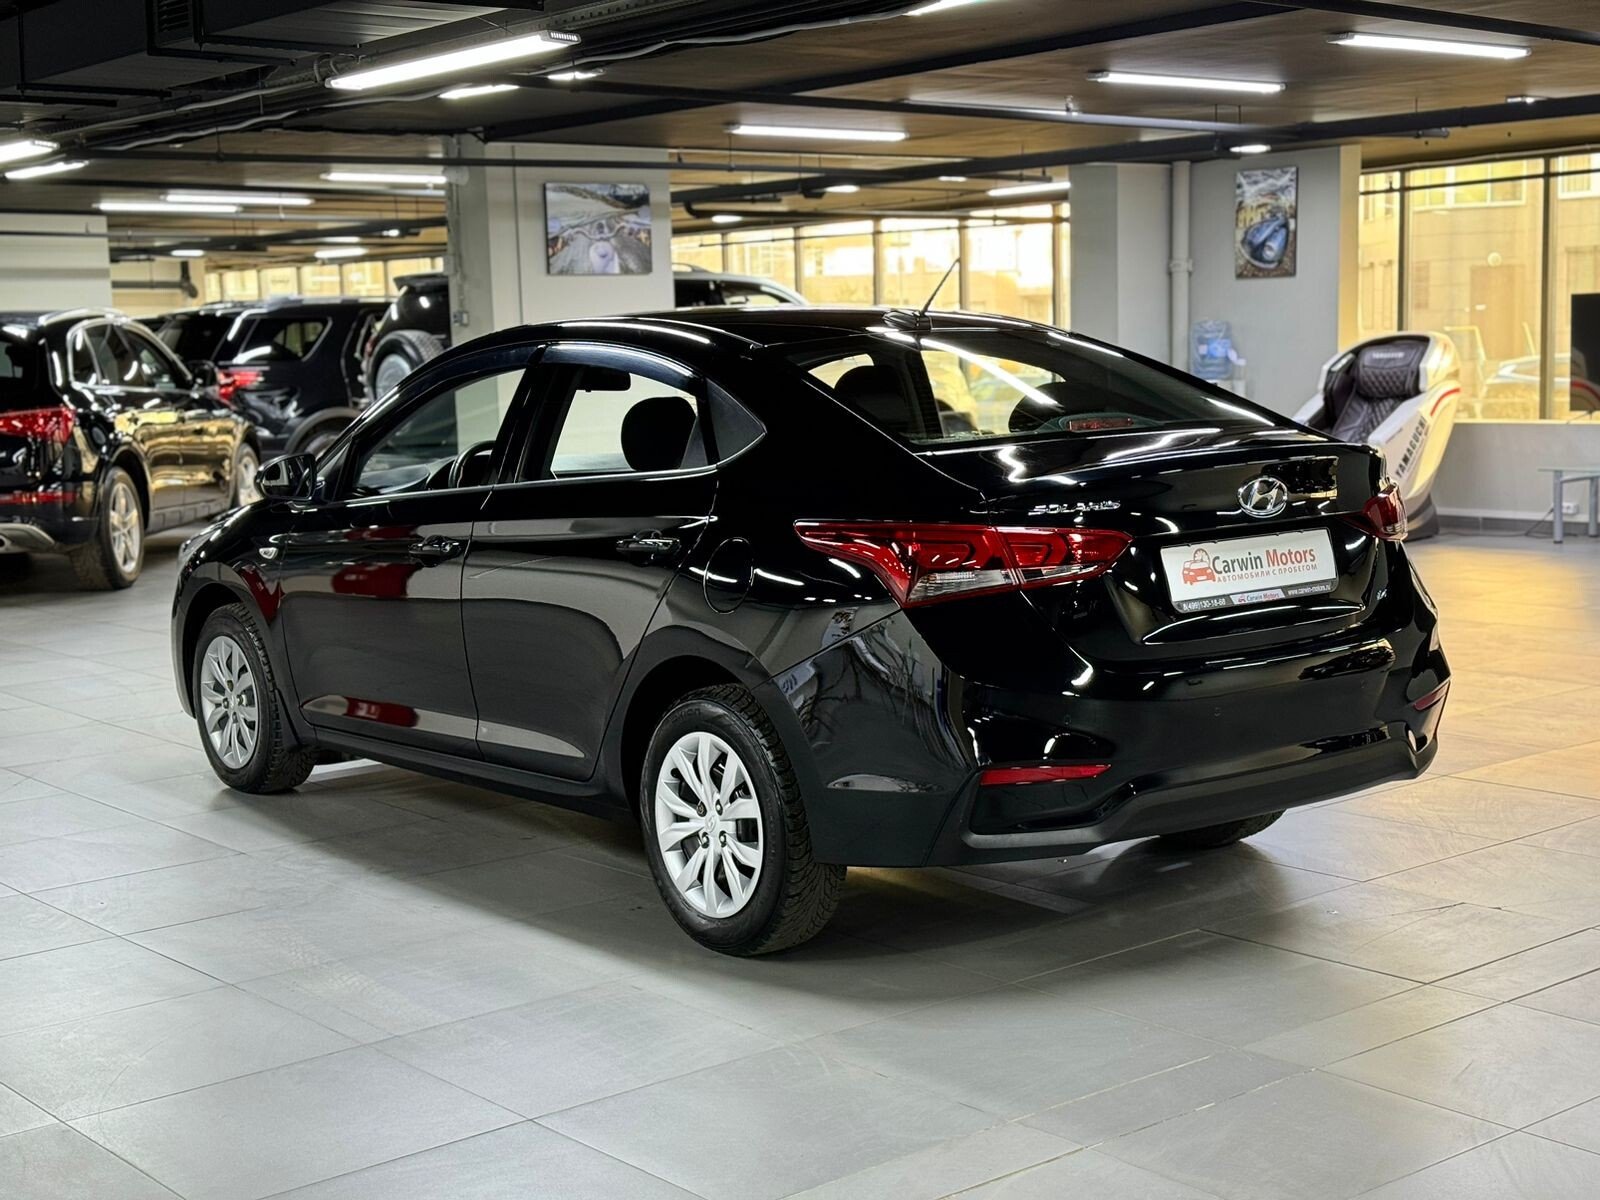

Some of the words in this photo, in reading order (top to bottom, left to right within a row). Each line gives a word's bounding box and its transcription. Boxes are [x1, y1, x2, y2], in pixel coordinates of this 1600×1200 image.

[1395, 415, 1428, 478] YAMAGUCHI
[1212, 552, 1263, 575] Carwin
[1265, 548, 1316, 567] Motors
[1217, 570, 1270, 583] АВТОМОБИЛИ
[1278, 563, 1318, 574] ПРОБЕГОМ
[1246, 593, 1263, 602] Carwin
[1263, 592, 1279, 600] Motors
